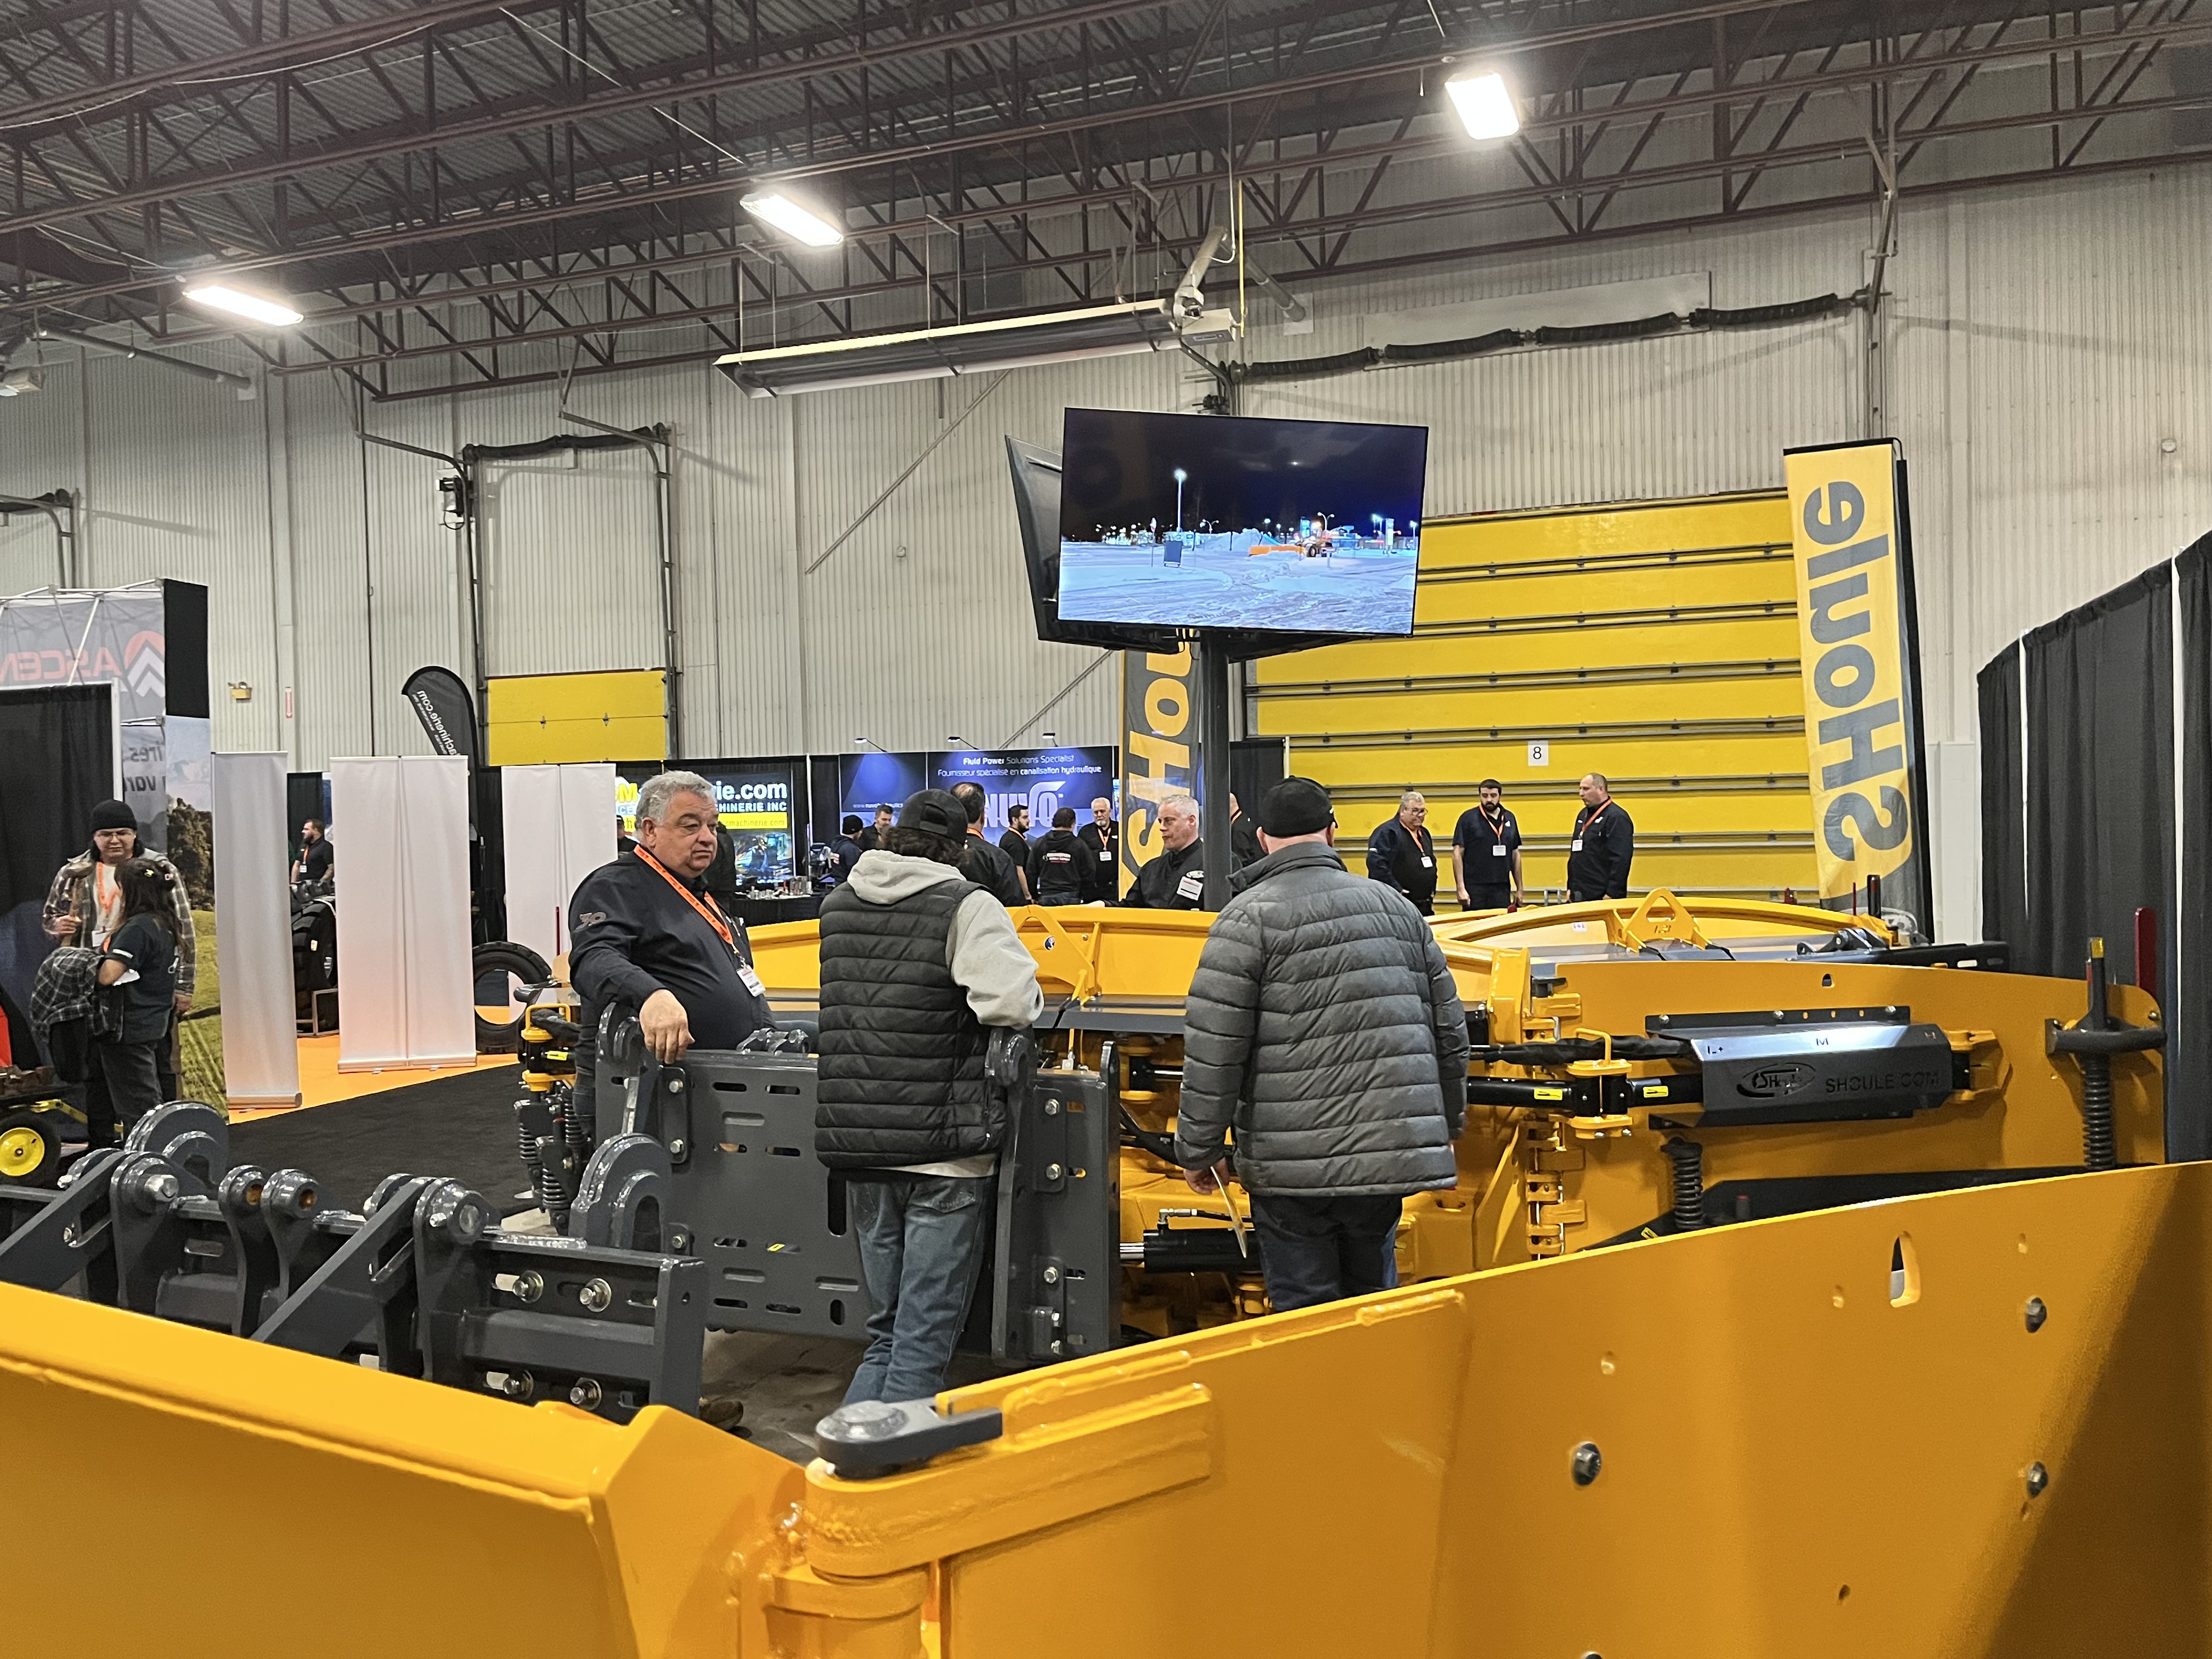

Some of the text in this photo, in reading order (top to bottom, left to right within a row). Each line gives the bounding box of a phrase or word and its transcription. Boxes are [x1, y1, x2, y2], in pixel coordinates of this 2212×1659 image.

[1533, 747, 1542, 759] 8
[1040, 755, 1074, 764] Specialist
[1020, 767, 1059, 775] canalisation
[1061, 766, 1102, 775] hydraulique
[767, 801, 787, 811] INC
